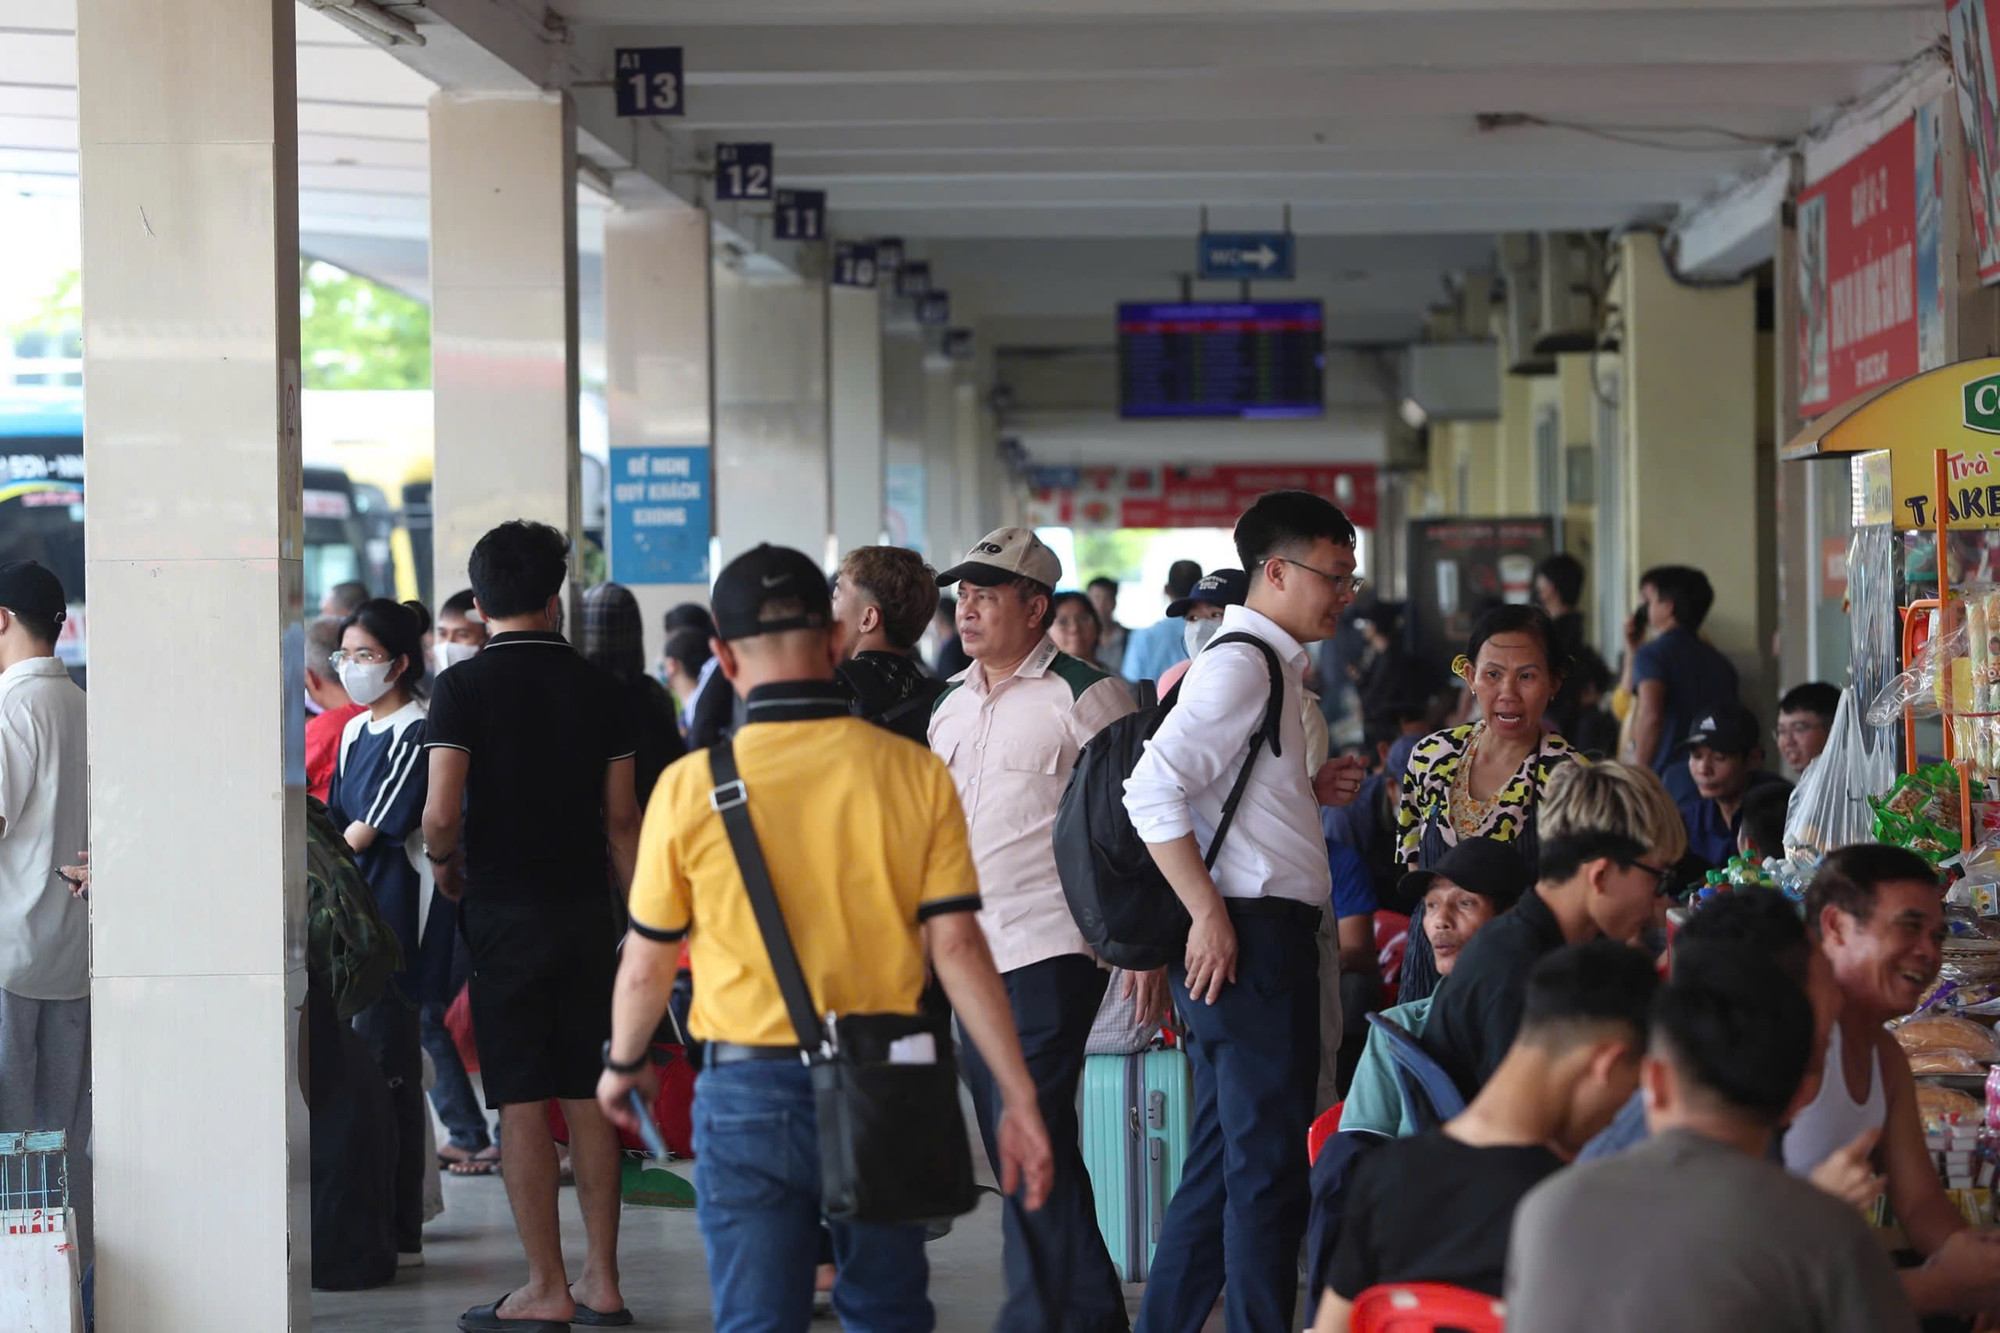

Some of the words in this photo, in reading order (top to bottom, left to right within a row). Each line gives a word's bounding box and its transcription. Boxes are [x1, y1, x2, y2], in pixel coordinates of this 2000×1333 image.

[619, 53, 641, 69] A1
[629, 72, 678, 110] 13
[726, 164, 769, 196] 12
[784, 208, 818, 237] 11
[842, 258, 875, 284] 10
[1974, 384, 2000, 415] C
[1946, 452, 1990, 480] Trà
